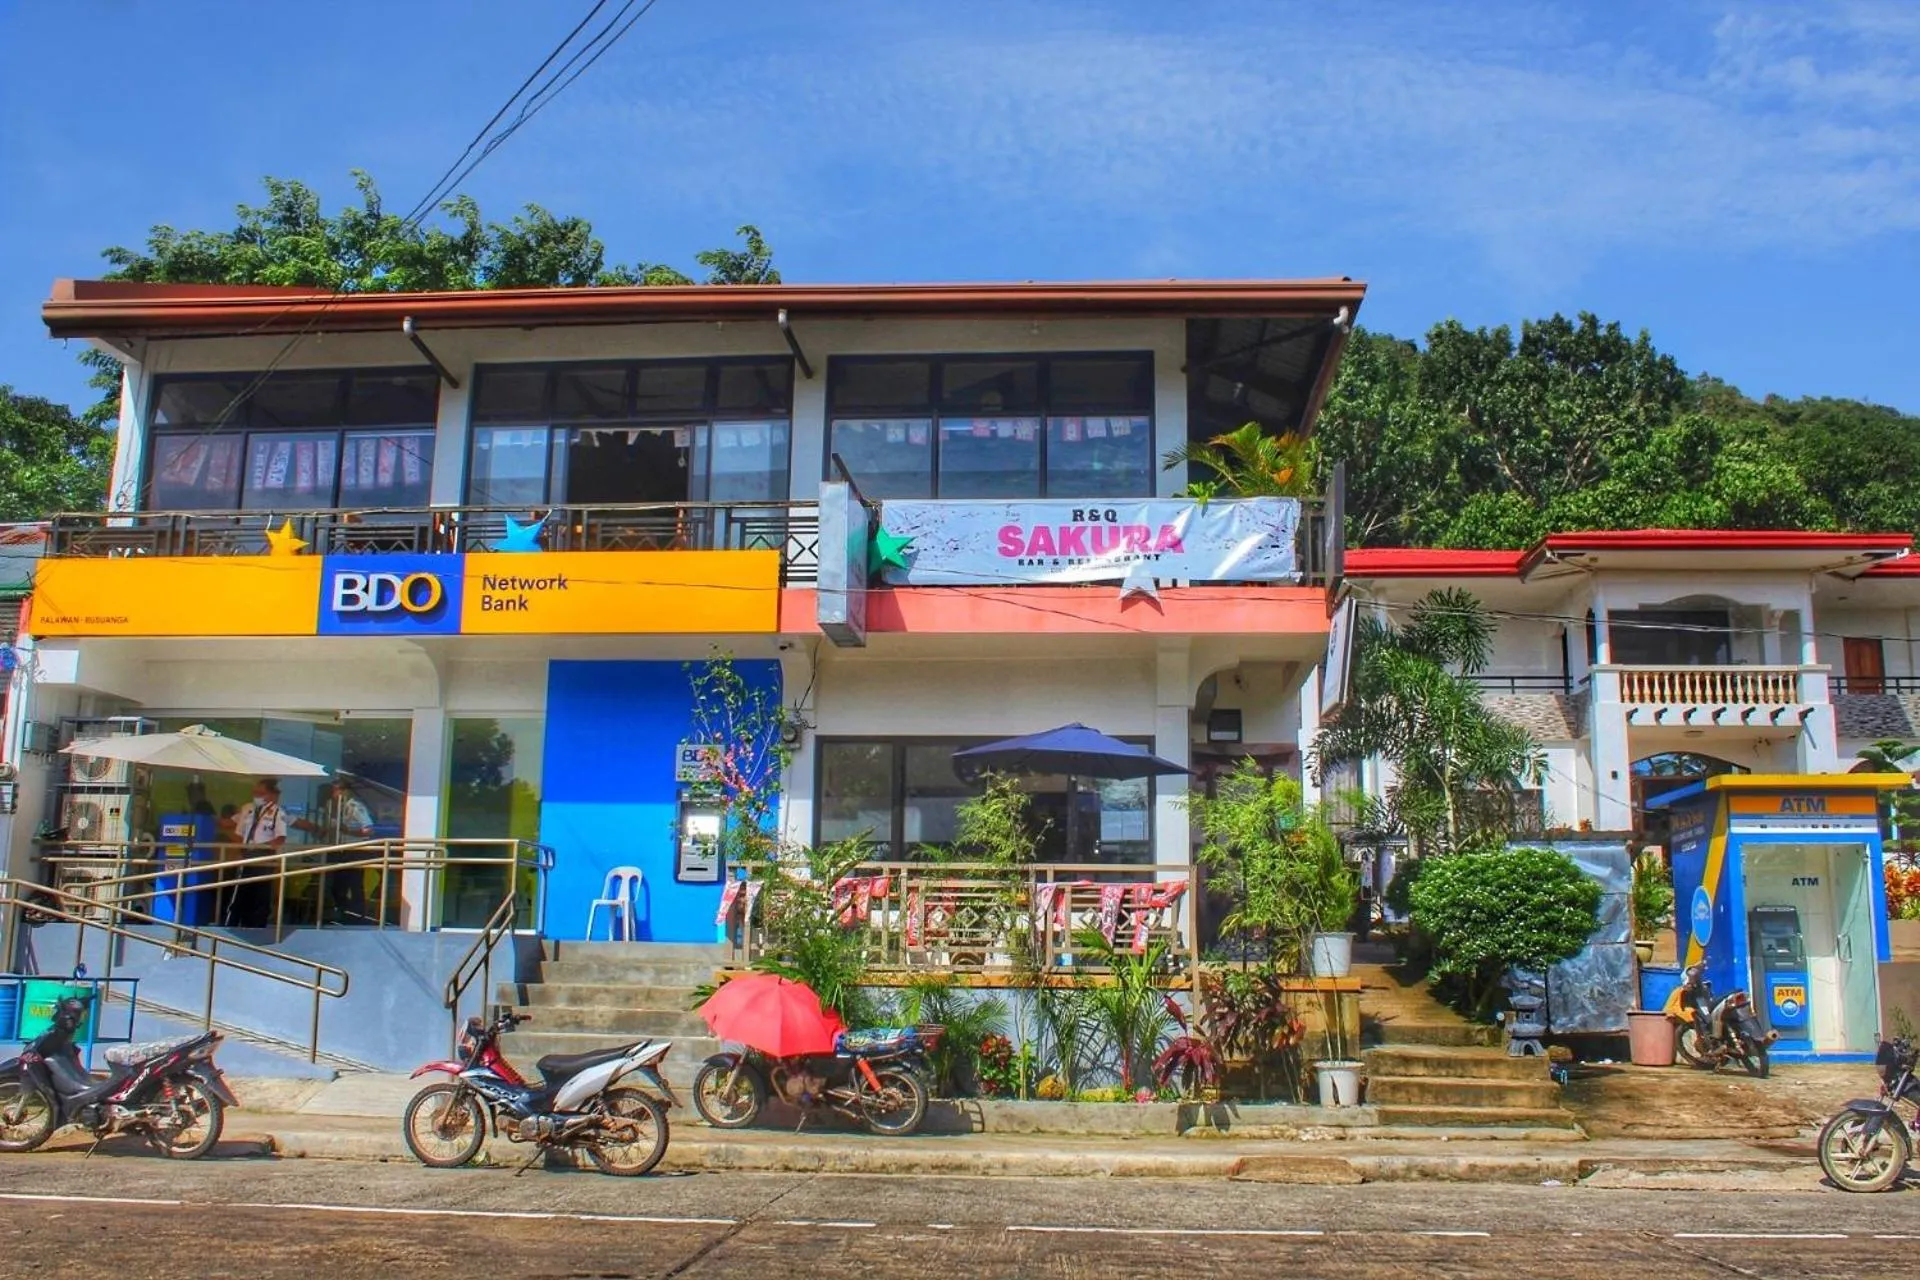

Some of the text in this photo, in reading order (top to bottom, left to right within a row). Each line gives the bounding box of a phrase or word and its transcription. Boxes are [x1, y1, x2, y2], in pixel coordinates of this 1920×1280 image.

[1072, 509, 1117, 523] R&Q
[997, 524, 1185, 558] SAKURA
[1018, 558, 1044, 566] BAR
[482, 574, 568, 591] Network
[332, 572, 441, 612] BDO
[481, 594, 529, 612] Bank
[1779, 797, 1827, 813] ATM
[1792, 877, 1819, 886] ATM
[1777, 988, 1802, 997] ATM
